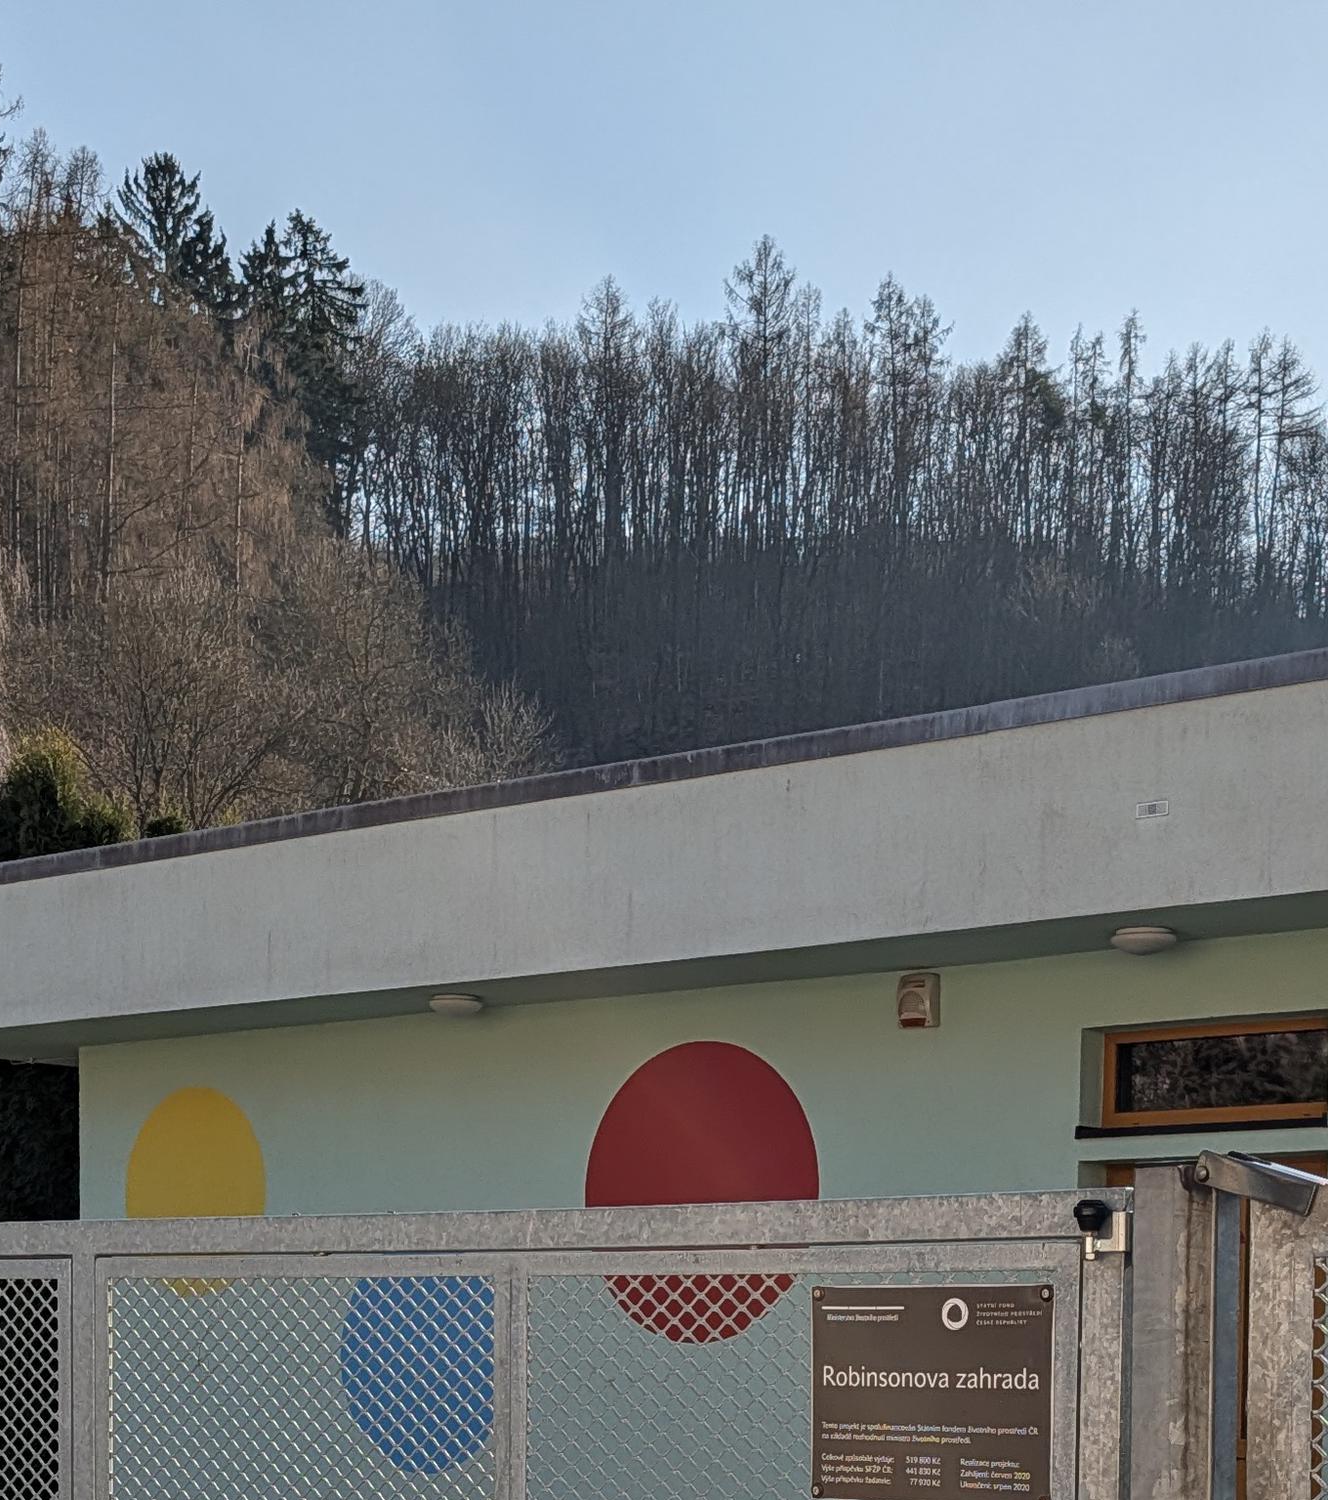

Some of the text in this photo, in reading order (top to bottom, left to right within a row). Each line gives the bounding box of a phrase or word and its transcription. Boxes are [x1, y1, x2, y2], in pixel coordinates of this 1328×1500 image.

[823, 1365, 1040, 1390] Robinsonova zahrada
[905, 1456, 918, 1464] 519
[932, 1457, 941, 1465] Kč
[905, 1467, 918, 1475] 441
[932, 1468, 941, 1476] Kč
[991, 1470, 1012, 1478] červen
[1013, 1472, 1030, 1480] 2020
[909, 1478, 918, 1486] 77
[932, 1479, 941, 1487] Kč
[1013, 1483, 1030, 1491] 2020
